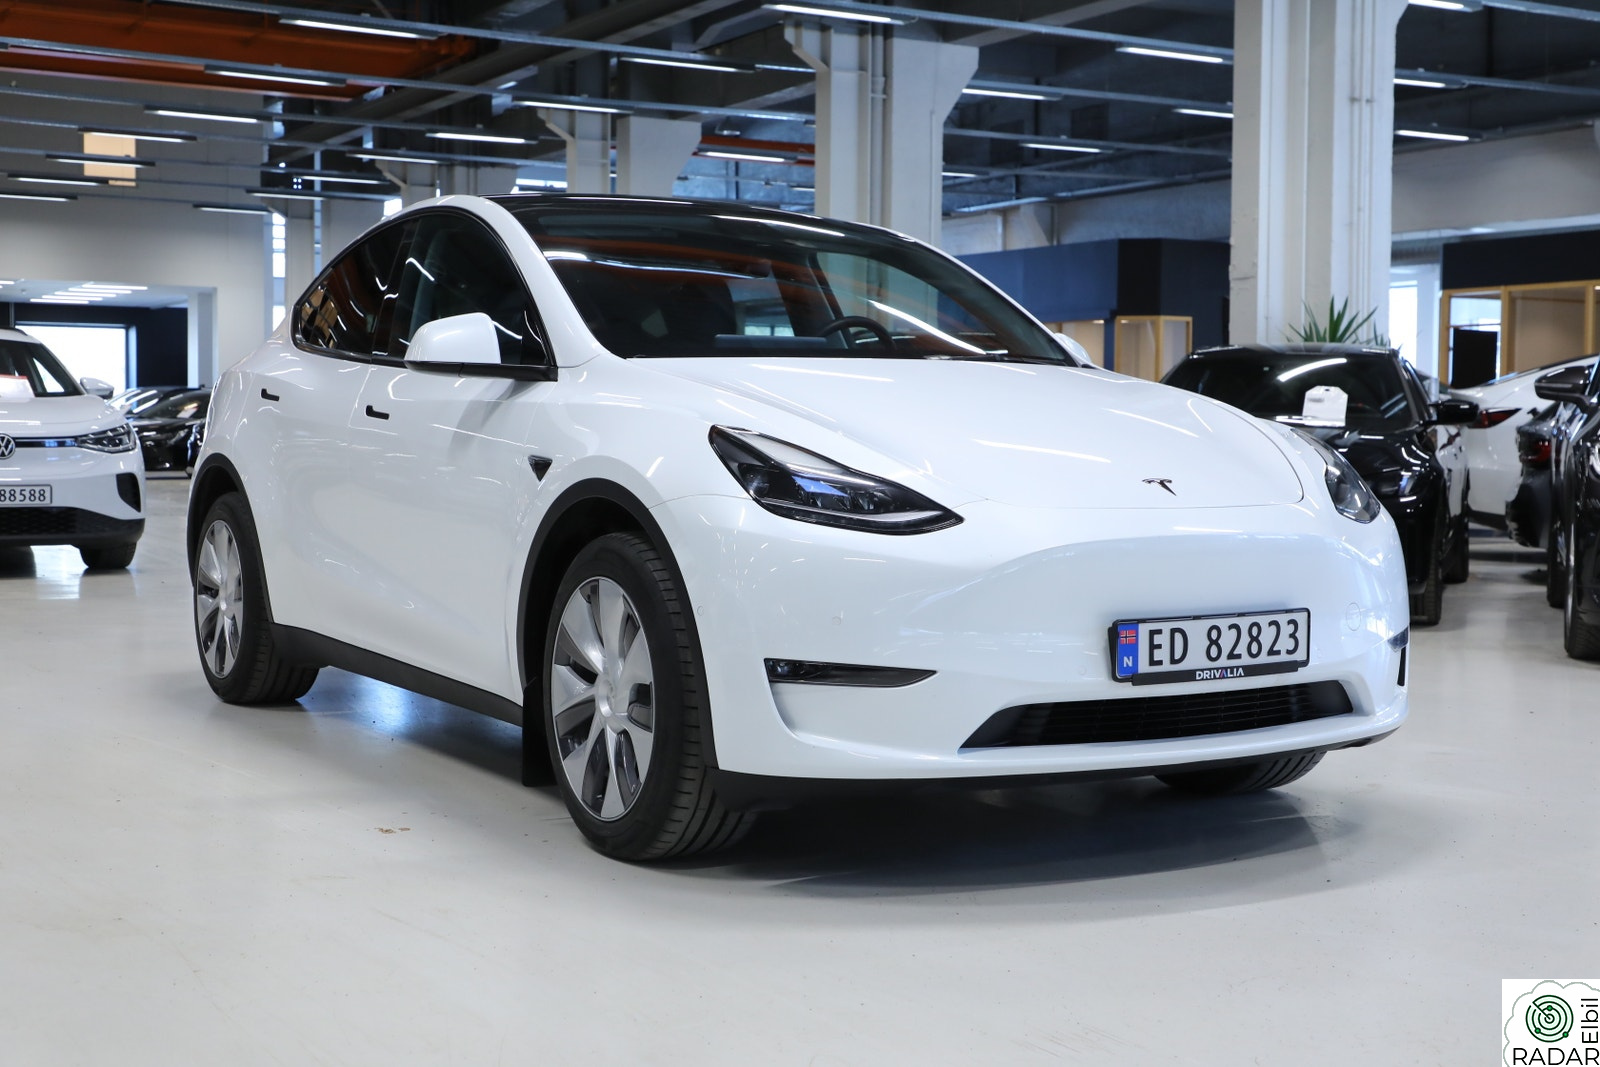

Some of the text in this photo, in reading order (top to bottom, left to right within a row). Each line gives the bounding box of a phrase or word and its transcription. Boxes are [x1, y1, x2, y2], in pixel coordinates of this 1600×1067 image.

[1149, 618, 1299, 666] ED 82823
[1123, 656, 1133, 668] N
[1195, 668, 1245, 680] DRIVALIA
